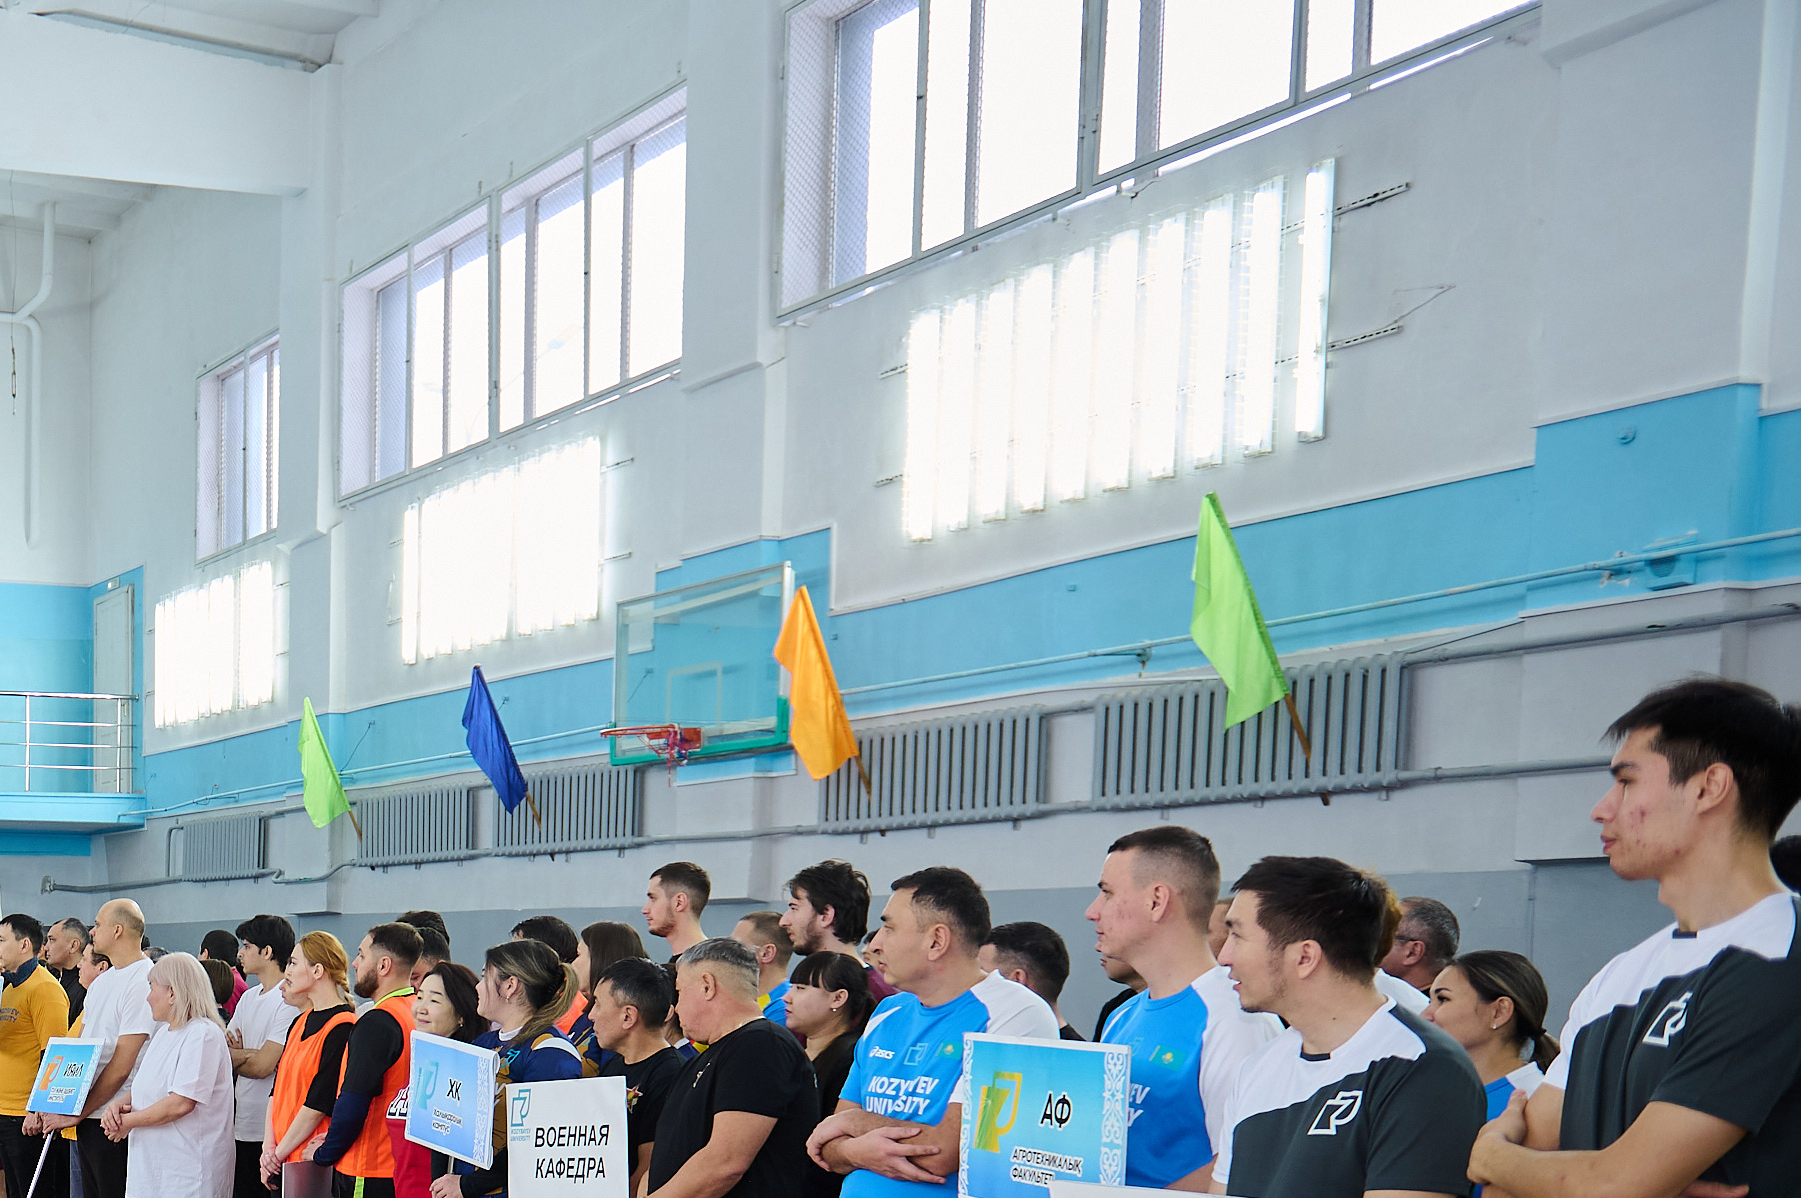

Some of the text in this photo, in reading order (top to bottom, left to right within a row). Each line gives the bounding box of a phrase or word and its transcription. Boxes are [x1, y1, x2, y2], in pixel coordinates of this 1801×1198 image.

[1040, 1093, 1072, 1129] АФ
[535, 1124, 610, 1148] ВОЕННАЯ
[535, 1156, 606, 1184] КАФЕДРА
[1012, 1148, 1082, 1174] АГРОТЕХНИКАЛЫҚ
